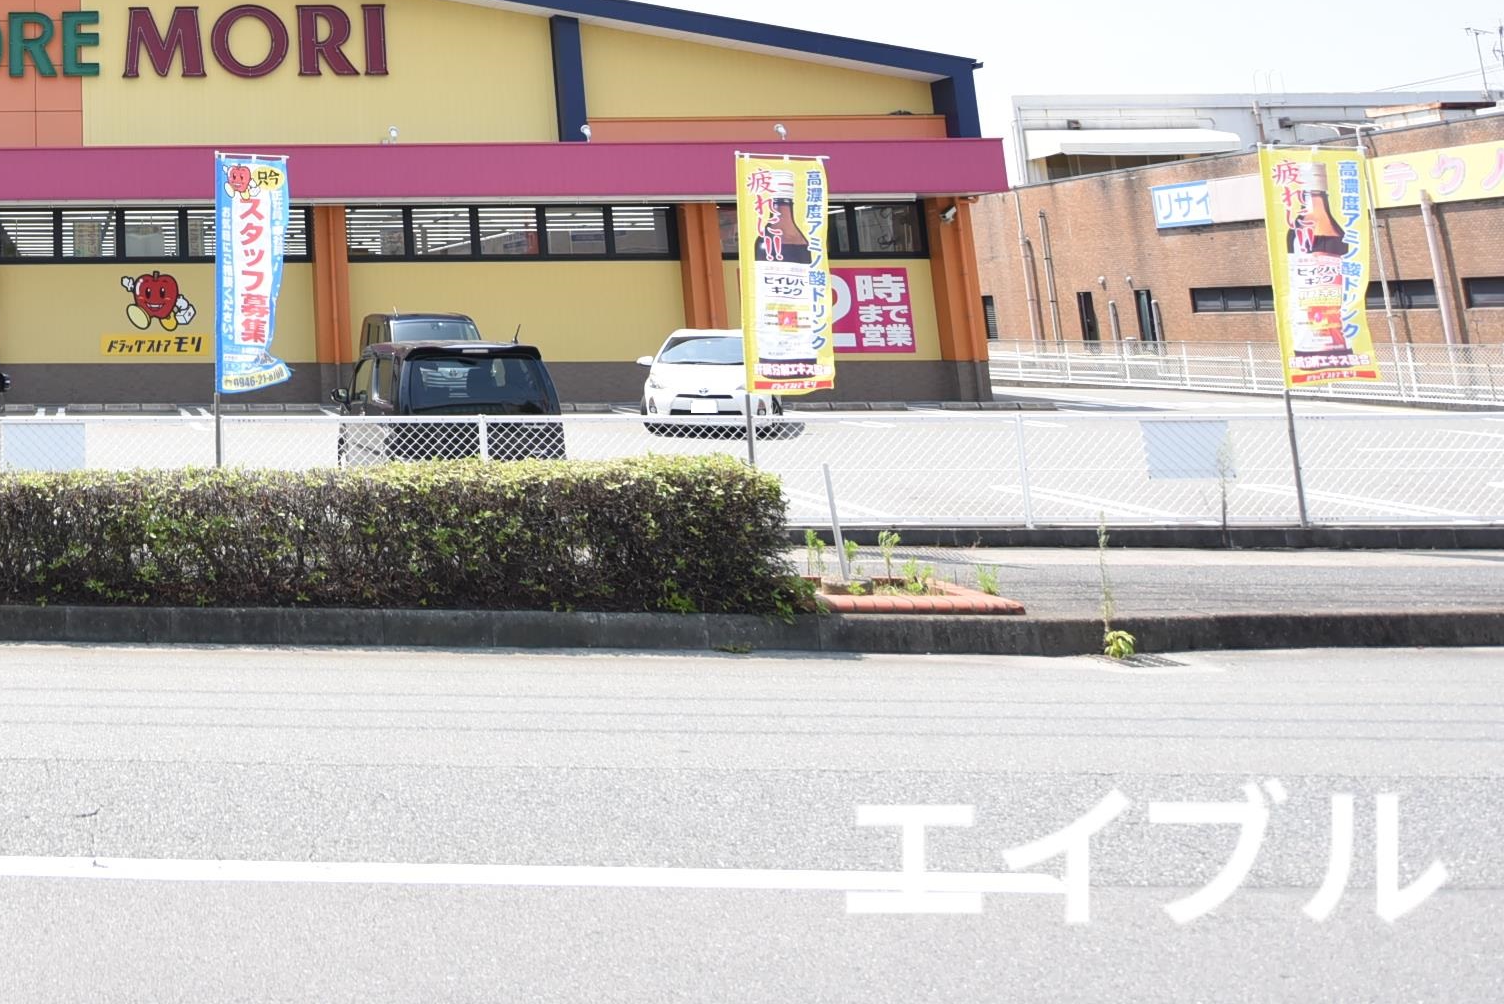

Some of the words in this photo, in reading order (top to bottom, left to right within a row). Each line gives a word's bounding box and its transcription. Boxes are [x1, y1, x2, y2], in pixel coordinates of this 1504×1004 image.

[122, 4, 390, 78] MORI
[257, 170, 280, 185] 只今
[239, 198, 270, 344] スタッフ募集
[805, 170, 827, 350] 高濃度アミノ酸ドリンク
[854, 274, 906, 303] 時
[858, 304, 909, 323] まで
[860, 324, 913, 347] 営業
